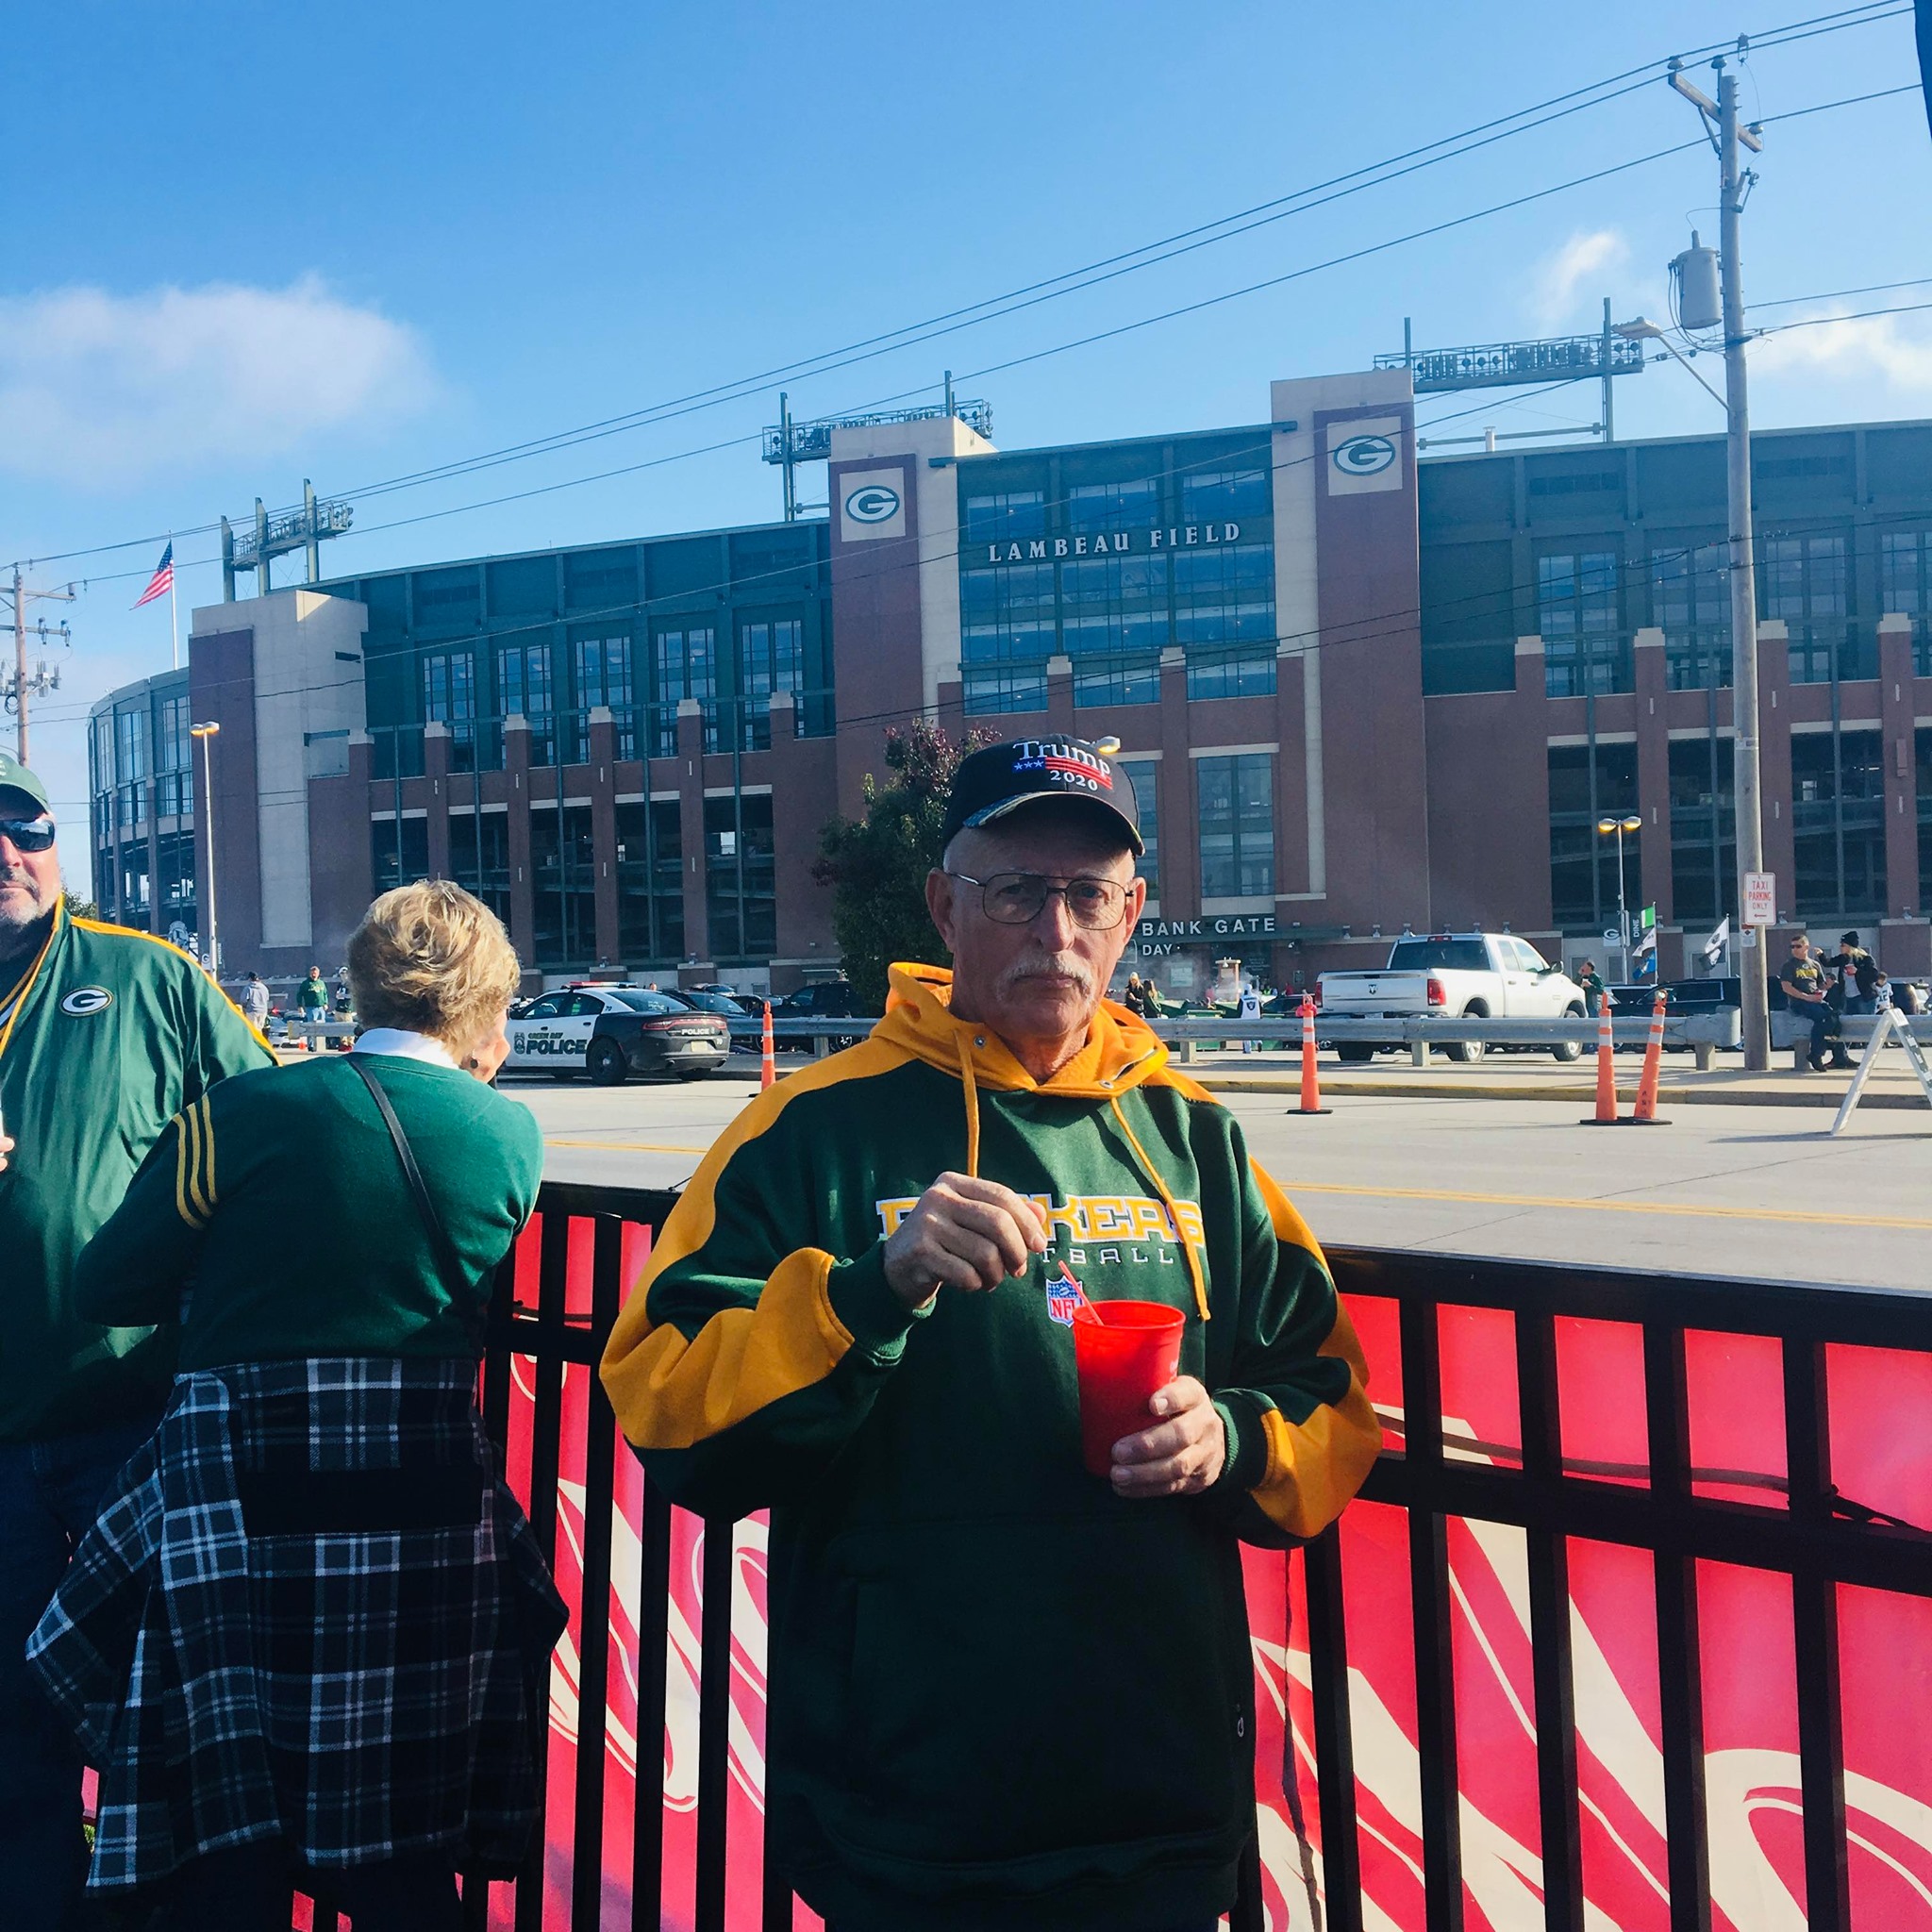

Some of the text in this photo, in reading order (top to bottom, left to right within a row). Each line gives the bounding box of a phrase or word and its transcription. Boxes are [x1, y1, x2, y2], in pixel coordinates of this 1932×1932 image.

[989, 523, 1241, 562] LAMBEAU FIELD
[1012, 741, 1111, 779] Trump
[1050, 770, 1099, 791] 2020
[1752, 880, 1769, 890] TAXI
[1748, 891, 1772, 901] PARKING
[1141, 917, 1275, 937] BANK GATE
[1632, 919, 1641, 938] DINE
[1142, 943, 1173, 957] DAY
[681, 1027, 710, 1036] POLICE
[526, 1039, 588, 1055] POLICE
[875, 1192, 1206, 1247] PKERS
